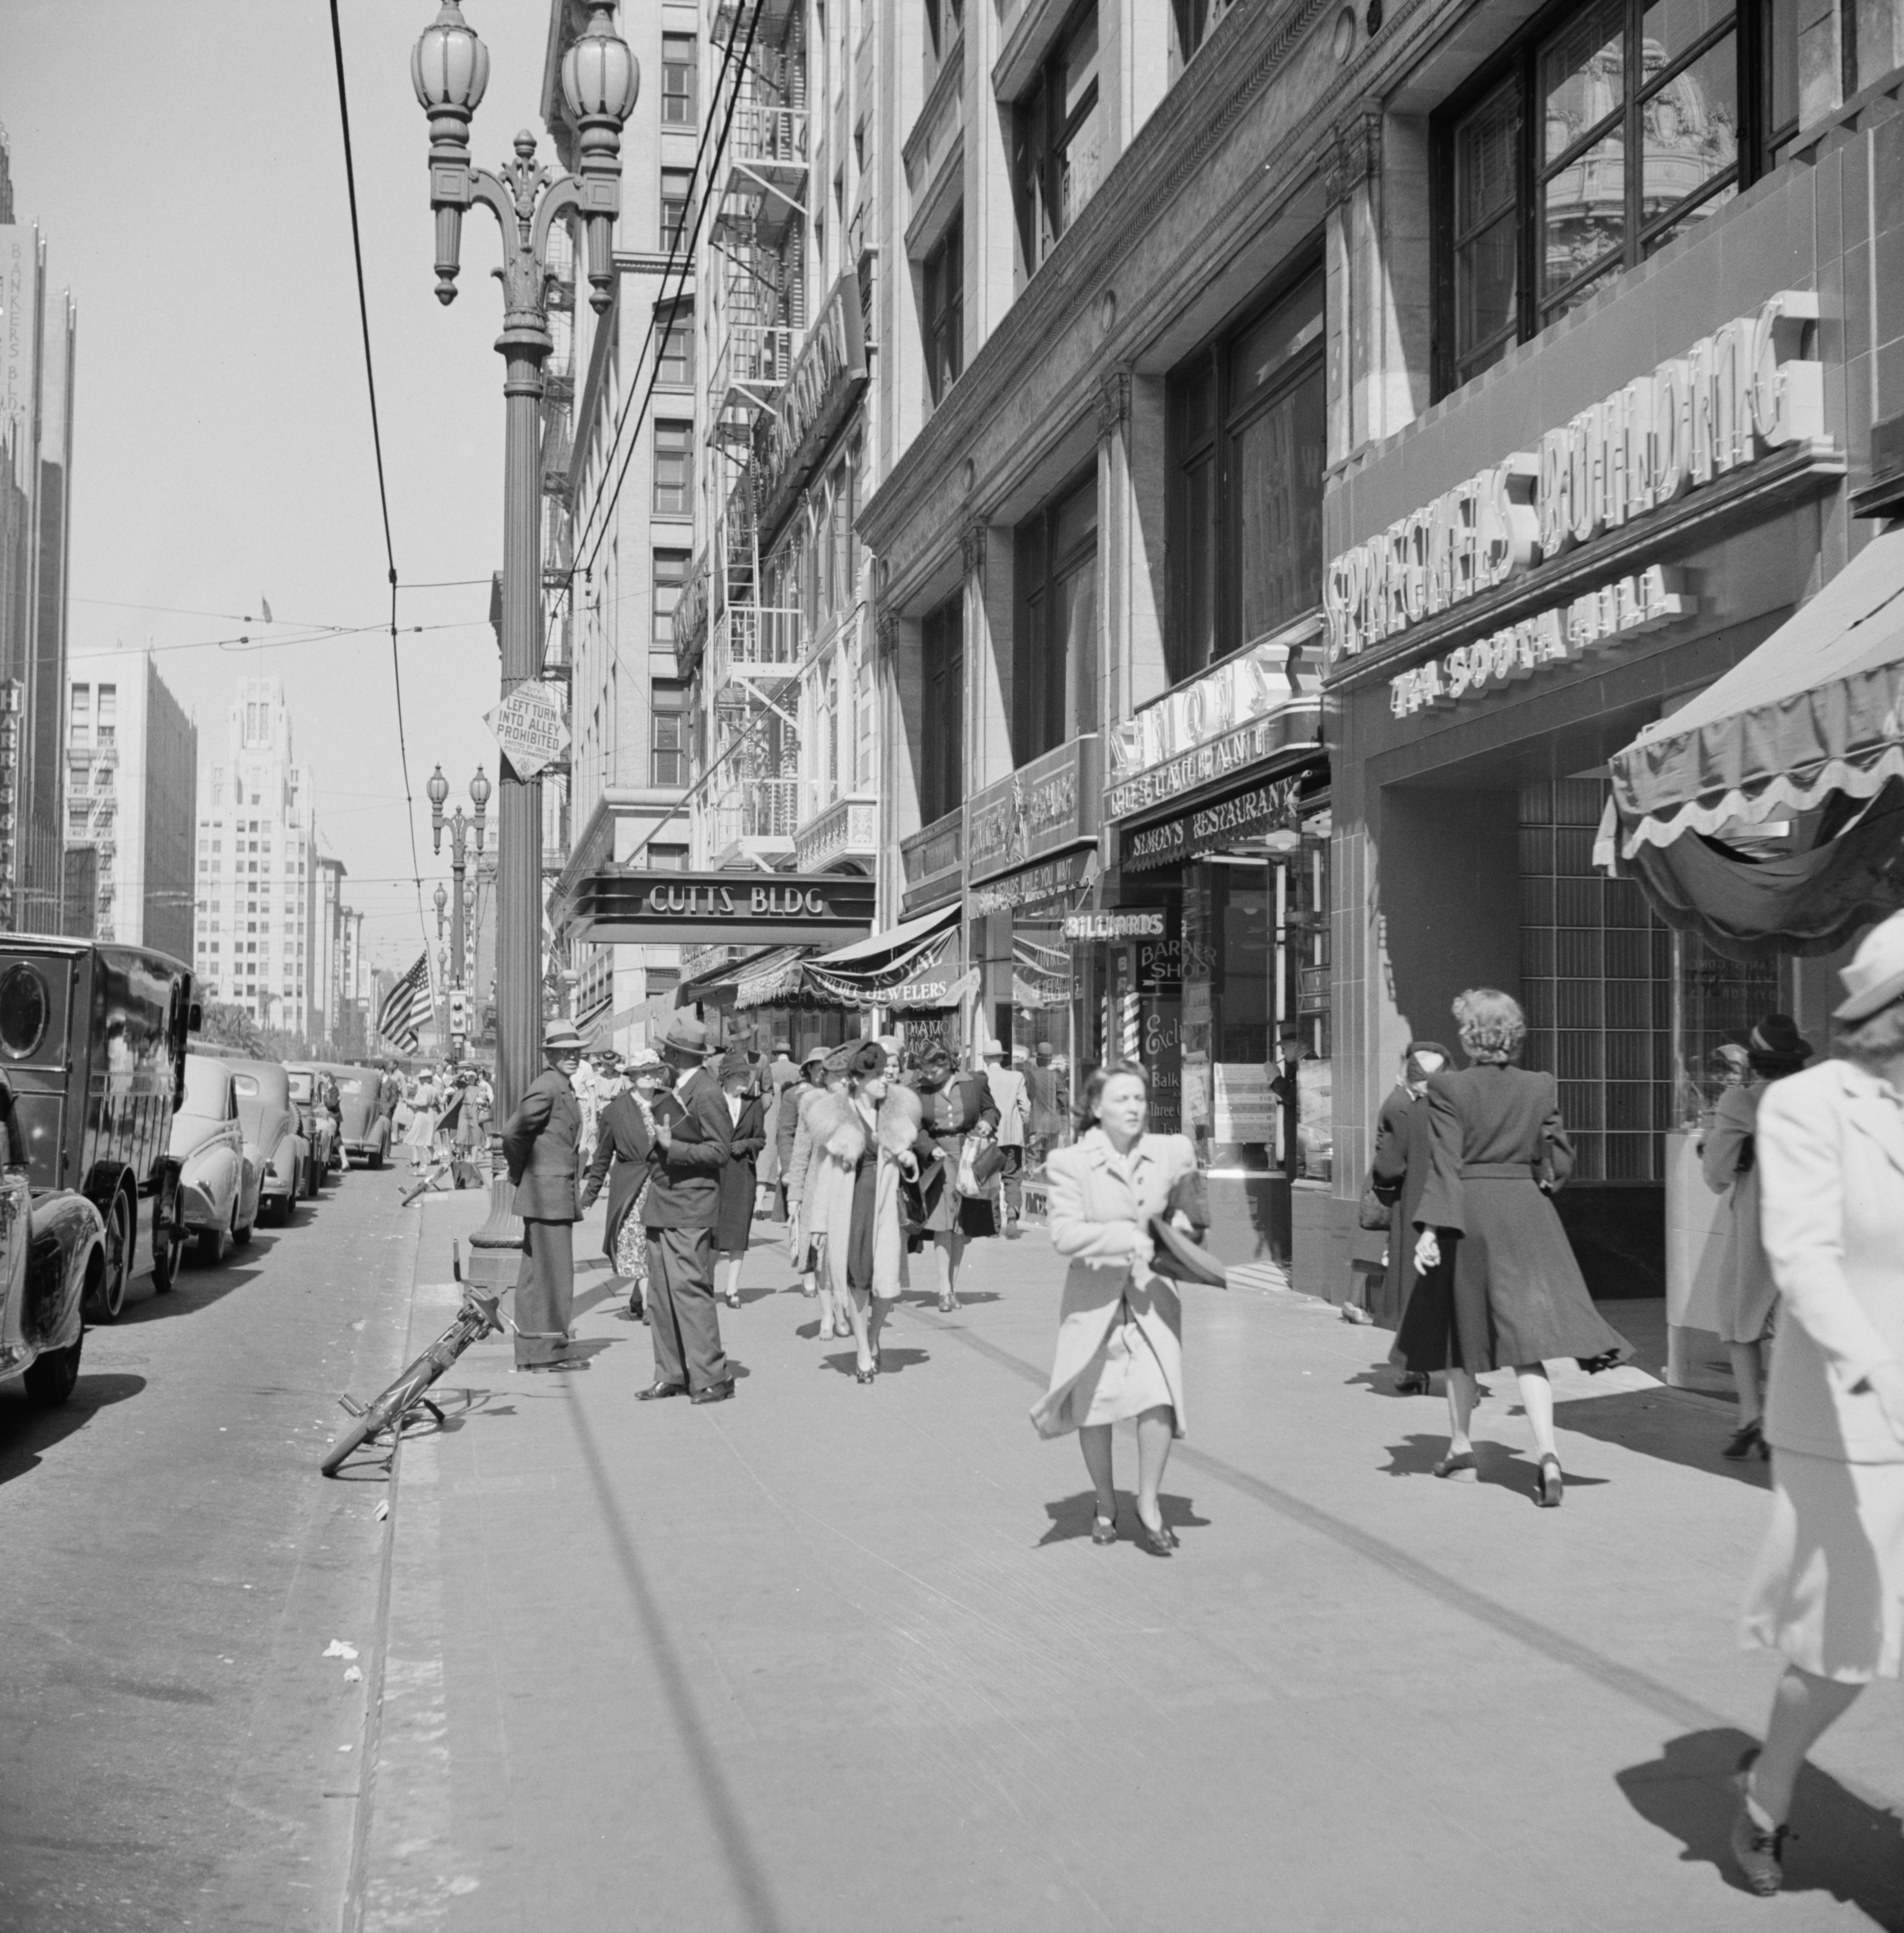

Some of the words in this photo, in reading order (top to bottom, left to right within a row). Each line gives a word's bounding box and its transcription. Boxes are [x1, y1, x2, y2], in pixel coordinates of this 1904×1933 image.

[9, 243, 21, 357] BANKERS
[1323, 451, 1540, 664] SPRECKELS
[1537, 290, 1824, 560] BUILDING
[1445, 608, 1567, 698] SOUTH
[1567, 563, 1683, 649] HILL
[507, 697, 531, 715] LEFT
[532, 704, 557, 722] TURN
[516, 689, 550, 703] ORDINANCE
[497, 724, 560, 750] PROHIBITED
[498, 710, 524, 727] INTO
[528, 718, 561, 737] ALLEY
[0, 688, 18, 804] HARRIS
[504, 745, 521, 754] POLICE
[521, 750, 550, 761] COMMISSION
[505, 739, 525, 749] ERECTED
[1111, 726, 1264, 816] RESTAURANT
[1131, 820, 1185, 857] SIMON'S
[1193, 777, 1292, 840] RESTAURANT
[1021, 869, 1039, 894] WHILE
[1040, 864, 1053, 889] YOU
[1056, 857, 1072, 883] WAIT
[650, 885, 734, 915] CUTTS
[751, 886, 824, 917] BLDG
[1142, 940, 1217, 968] BARBER
[872, 950, 942, 986] ROYAL
[1151, 962, 1210, 978] SHOP
[816, 974, 862, 997] CREDIT
[865, 981, 947, 1001] JEWELERS
[1145, 1014, 1181, 1055] Excl
[1151, 1072, 1181, 1088] Balk
[1150, 1101, 1175, 1118] Three
[1161, 1123, 1181, 1134] Tab
